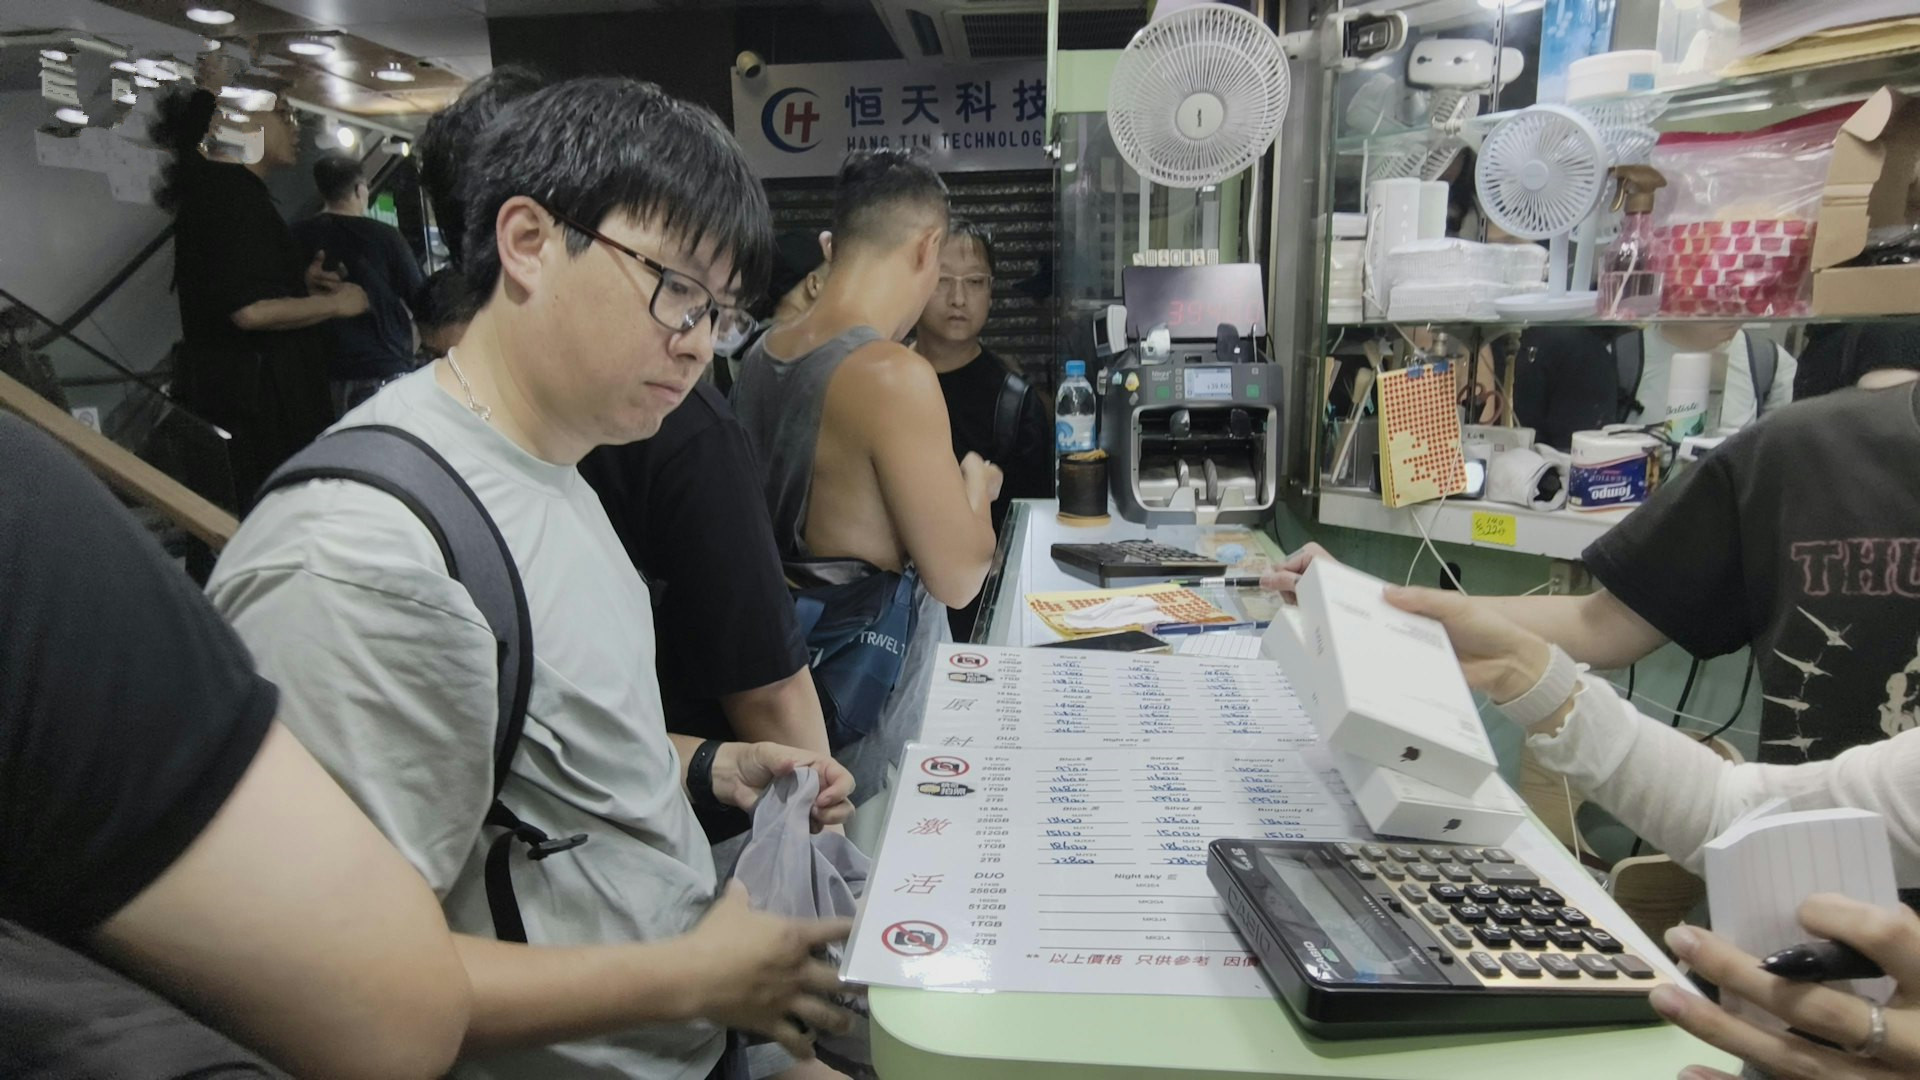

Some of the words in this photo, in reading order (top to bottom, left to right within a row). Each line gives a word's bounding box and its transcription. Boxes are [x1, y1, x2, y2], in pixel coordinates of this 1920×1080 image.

[844, 79, 1047, 127] 恒天科技
[847, 136, 890, 151] HANG
[943, 130, 1046, 149] TECHNOLOG
[1588, 480, 1636, 502] Tempo
[860, 631, 898, 655] TRAVEL
[894, 874, 944, 894] 活
[1440, 886, 1456, 895] 9
[1531, 907, 1549, 915] 2
[1562, 907, 1585, 920] 00
[1049, 953, 1123, 966] 以上價格
[1136, 954, 1210, 966] 只供參考
[1303, 941, 1332, 971] CASIO
[1511, 953, 1535, 967] AC
